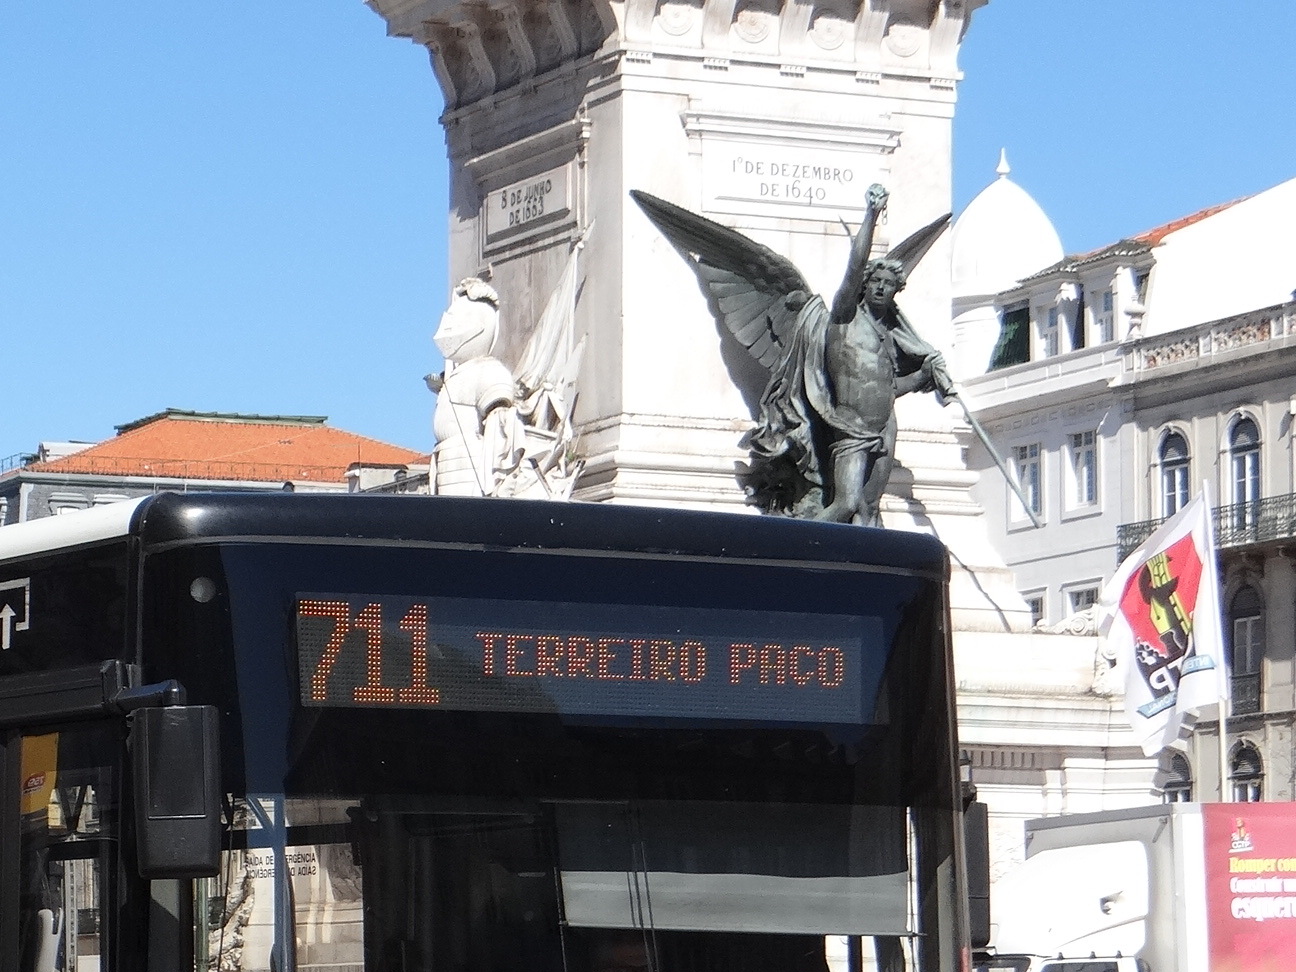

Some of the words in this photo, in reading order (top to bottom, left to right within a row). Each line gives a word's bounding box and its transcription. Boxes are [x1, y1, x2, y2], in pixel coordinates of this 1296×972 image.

[744, 160, 765, 176] DE
[770, 162, 854, 185] DEZEMBRO
[501, 189, 508, 210] 8
[510, 189, 522, 207] DE
[524, 179, 552, 201] JUNHO
[760, 182, 780, 198] DE
[785, 179, 826, 206] 1640
[509, 209, 521, 226] DE
[299, 599, 439, 703] 711
[475, 631, 706, 683] TERREIRO
[265, 856, 274, 865] DE
